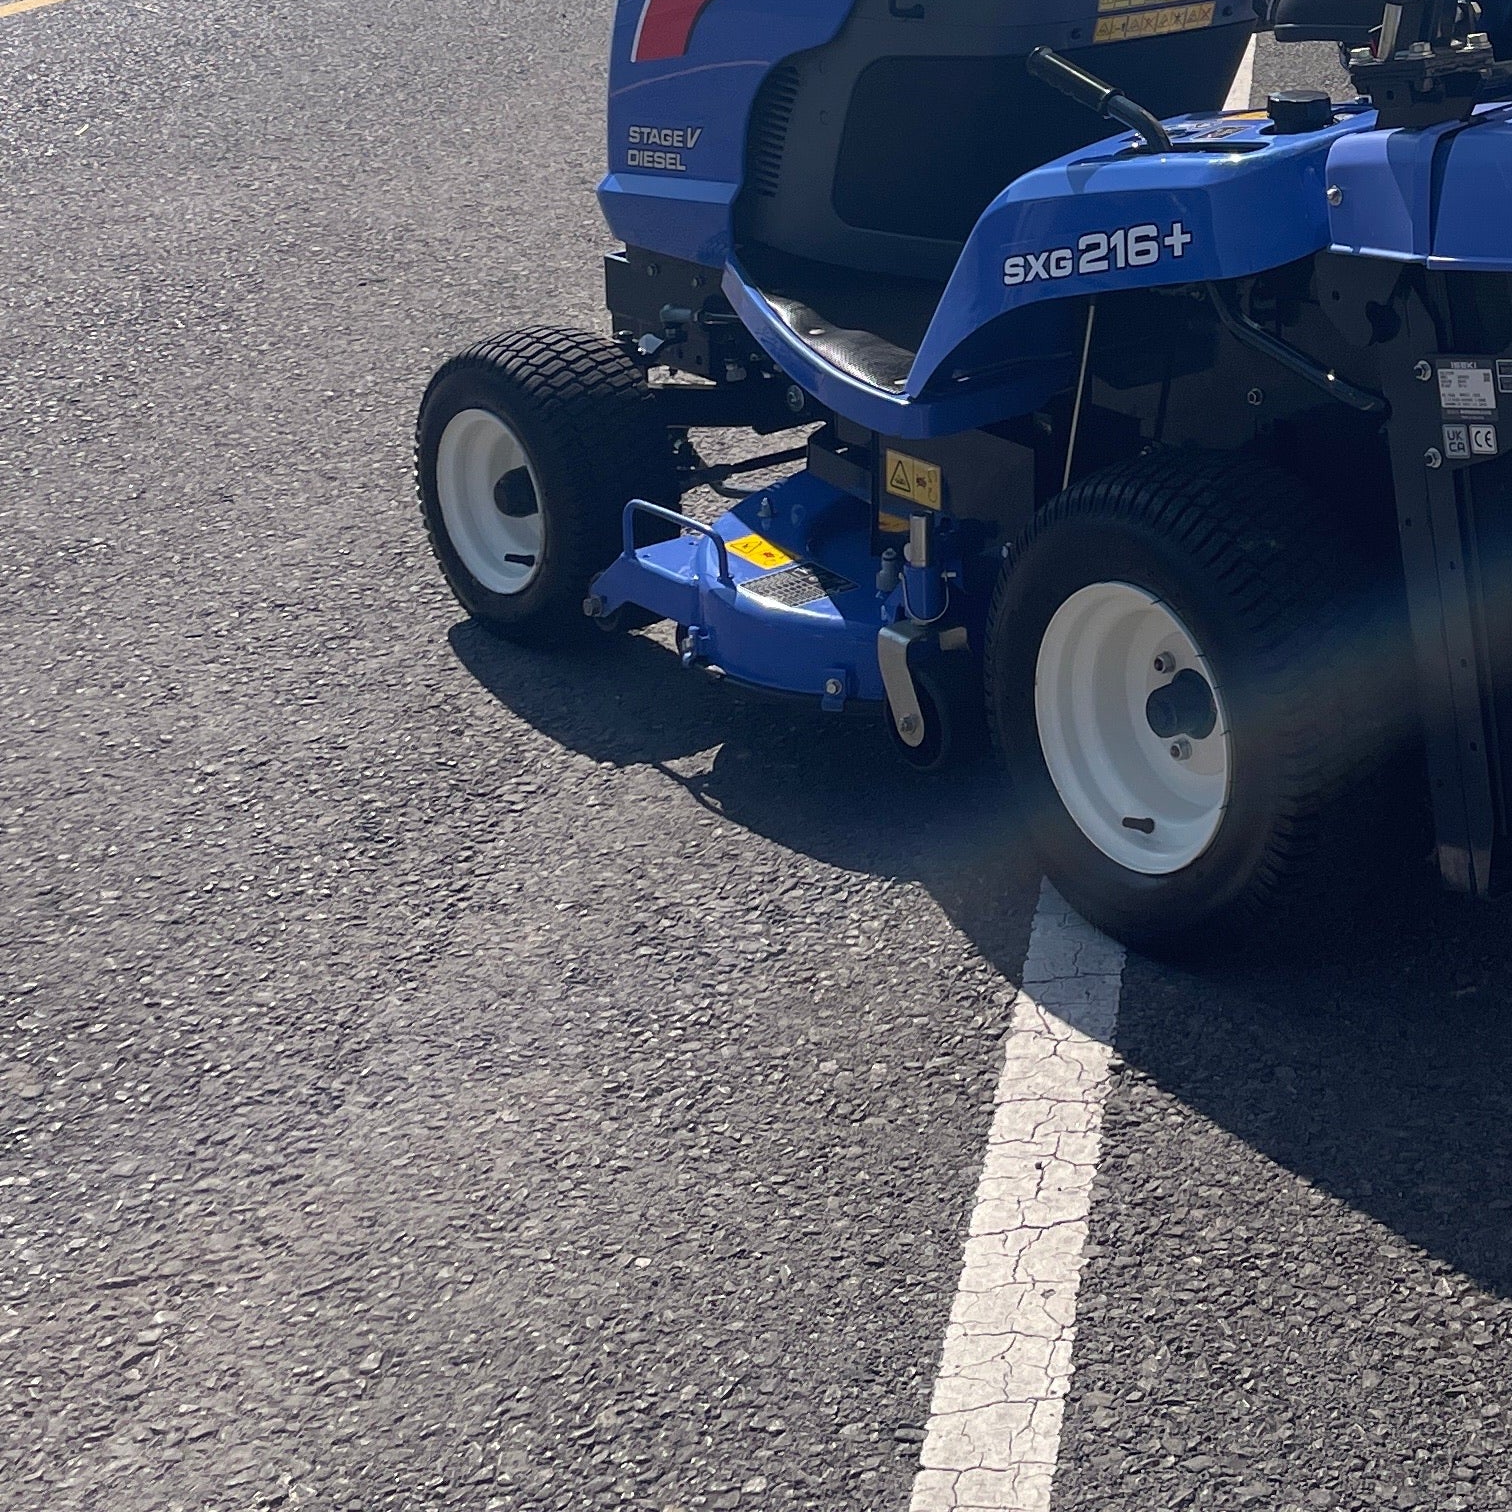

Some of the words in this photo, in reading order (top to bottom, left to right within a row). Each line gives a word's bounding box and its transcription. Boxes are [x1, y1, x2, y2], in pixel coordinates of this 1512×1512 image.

[628, 126, 684, 147] STAGE
[686, 127, 702, 148] V
[627, 149, 687, 170] DIESEL
[1474, 430, 1494, 449] CE
